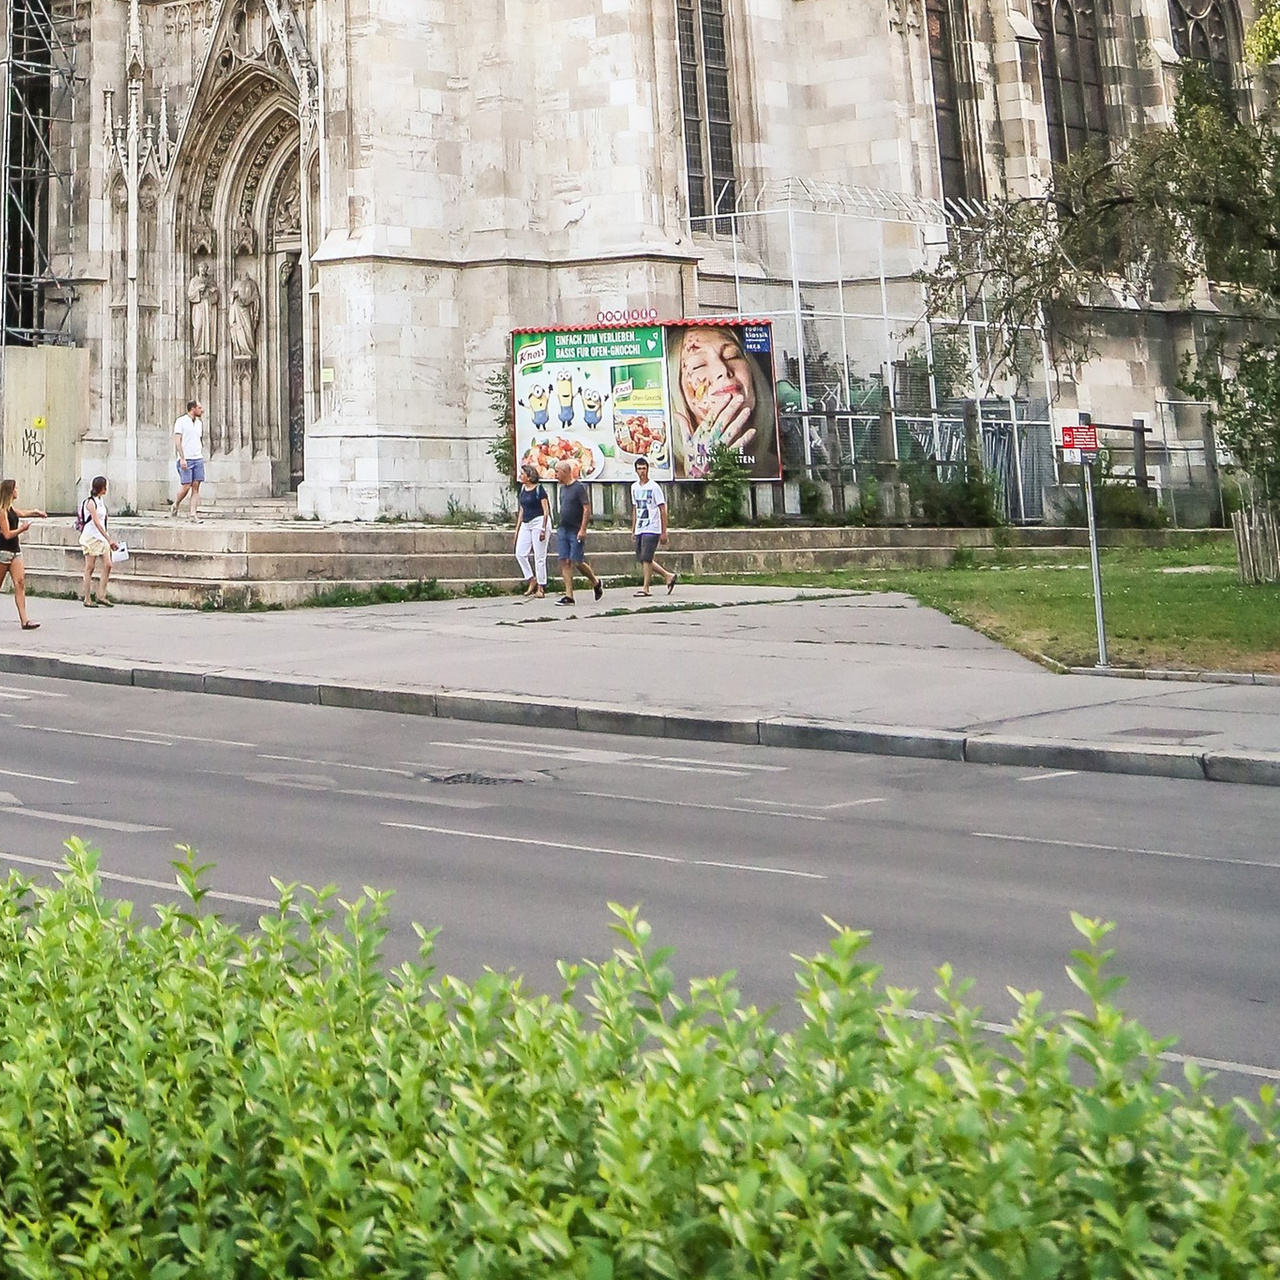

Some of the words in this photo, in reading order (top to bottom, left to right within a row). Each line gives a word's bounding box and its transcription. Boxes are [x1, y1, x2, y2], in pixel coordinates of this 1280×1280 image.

[555, 333, 582, 346] EINFACH
[583, 332, 598, 344] ZUM
[519, 348, 545, 364] Knorr
[555, 347, 576, 359] BASIS
[590, 344, 641, 357] OFEN-GNOCCHI
